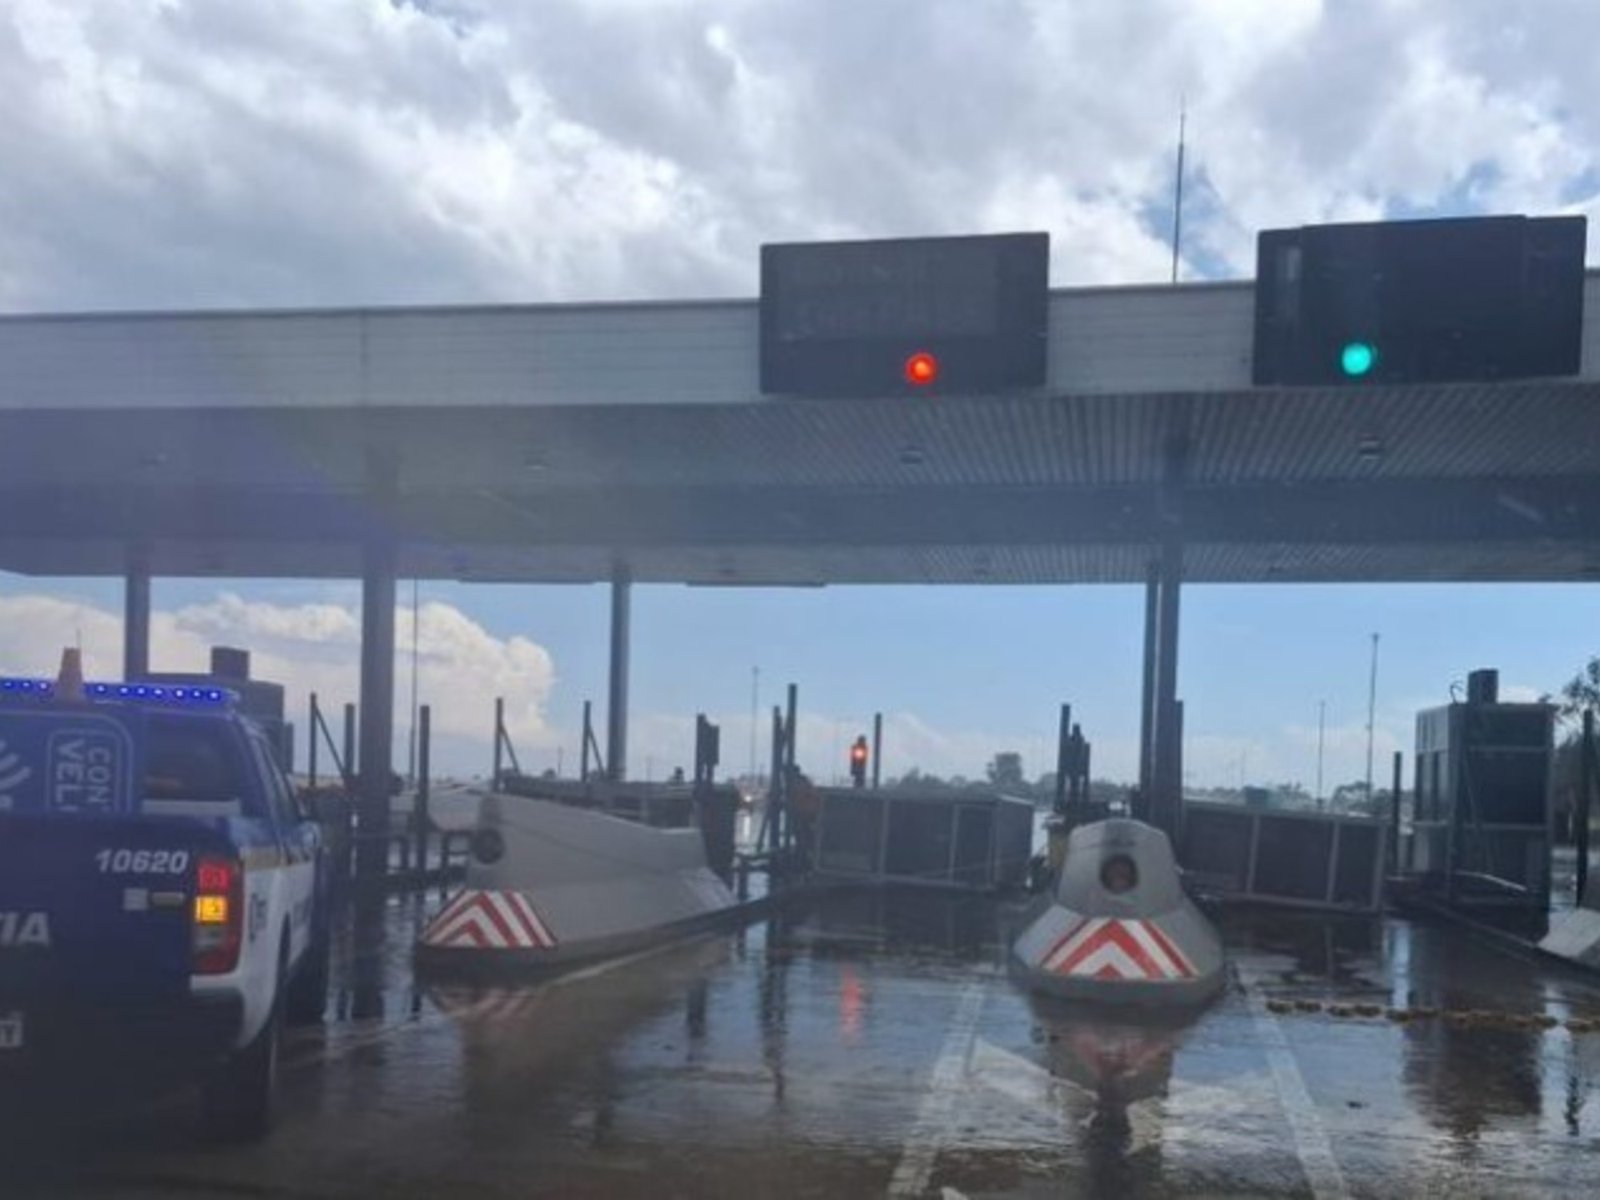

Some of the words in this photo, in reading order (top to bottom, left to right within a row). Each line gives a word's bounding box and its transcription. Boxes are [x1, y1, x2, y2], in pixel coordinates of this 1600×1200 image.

[87, 747, 111, 811] CON
[96, 848, 188, 873] 10620
[0, 911, 50, 948] IA
